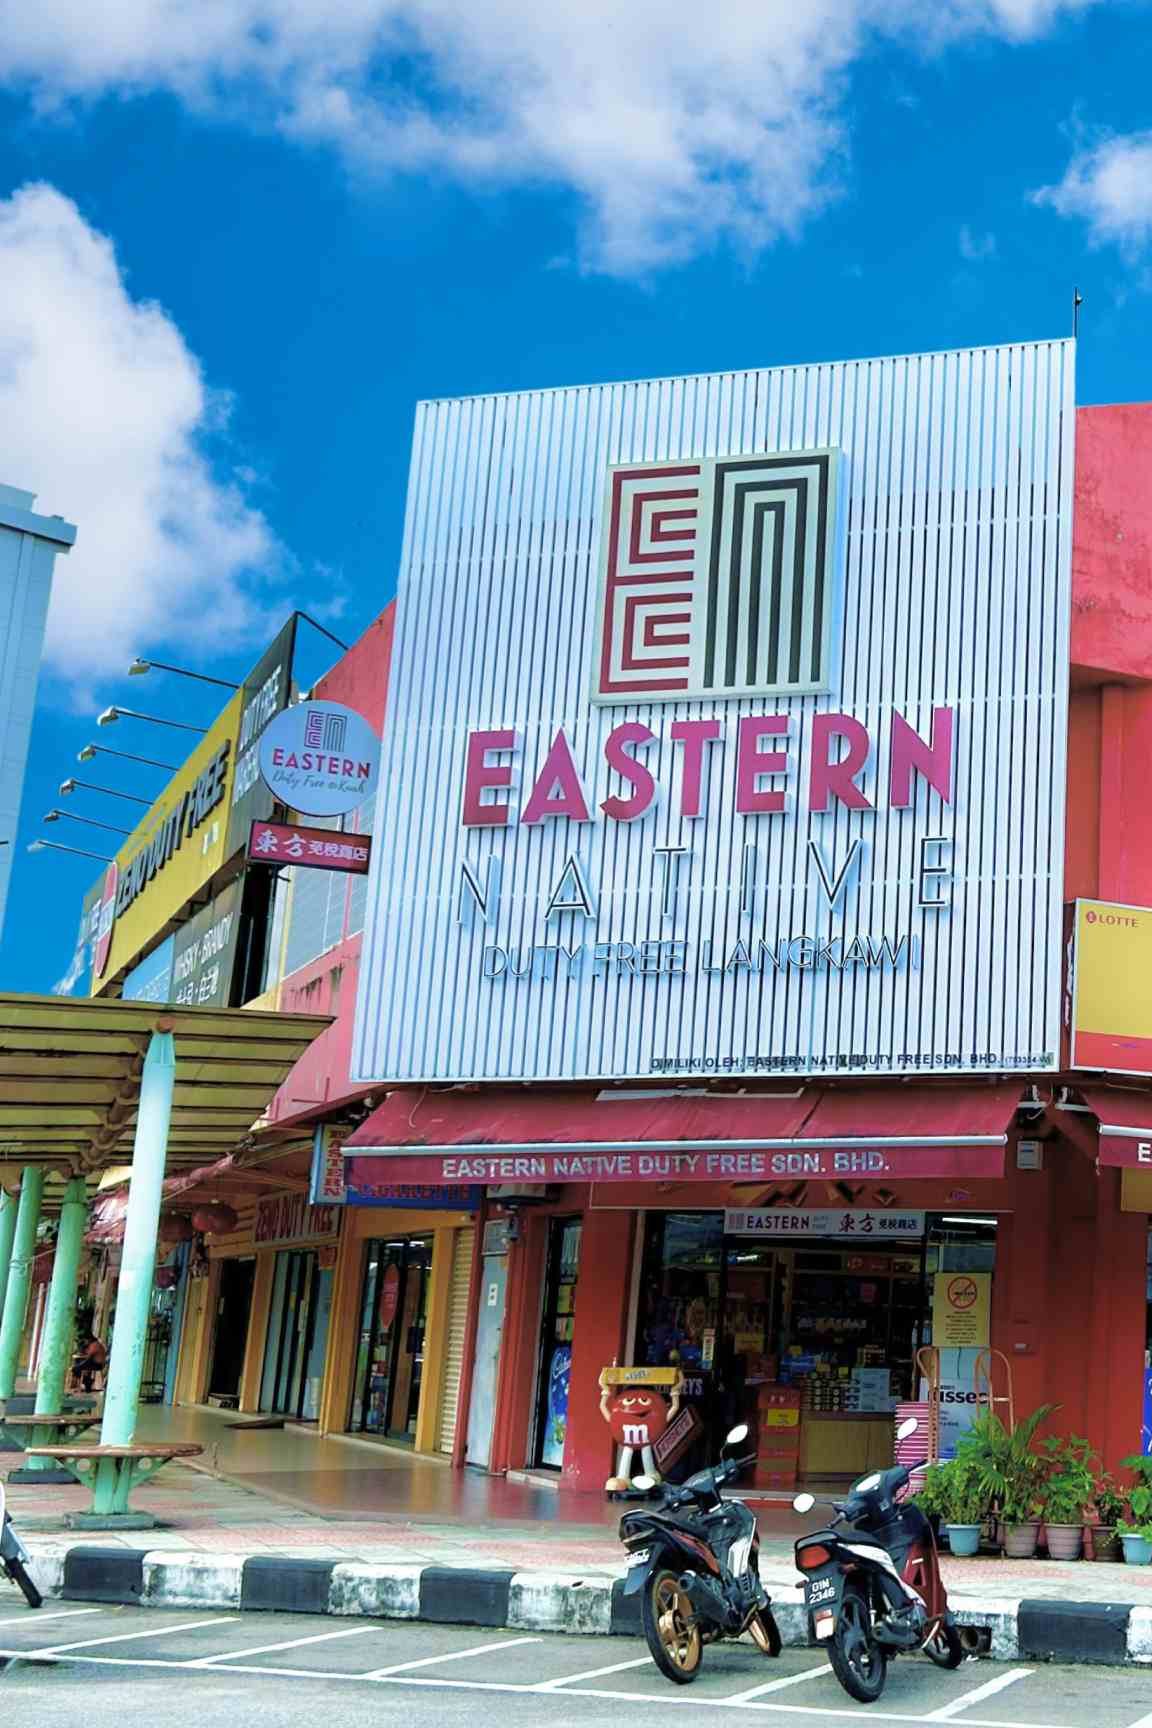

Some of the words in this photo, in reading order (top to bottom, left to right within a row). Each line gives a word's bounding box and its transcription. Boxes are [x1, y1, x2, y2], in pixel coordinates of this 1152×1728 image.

[272, 749, 371, 779] EASTERN
[462, 706, 955, 828] EASTERN
[303, 774, 325, 788] Free
[457, 835, 952, 925] NATIVE
[1099, 913, 1140, 929] LOTTE
[483, 943, 586, 980] DUTY
[593, 939, 688, 977] FREE
[701, 933, 920, 974] LANGKAWI
[748, 1055, 807, 1067] EASTERN
[862, 1054, 893, 1065] DUTY
[897, 1053, 932, 1065] FREE
[442, 1157, 546, 1178] EASTERN
[554, 1155, 633, 1176] NATIVE
[638, 1154, 701, 1174] DUTY
[706, 1153, 765, 1173] FREE
[771, 1152, 827, 1173] SDN.
[834, 1151, 890, 1172] BHD.
[746, 1215, 809, 1230] EASTERN
[622, 1424, 649, 1444] m
